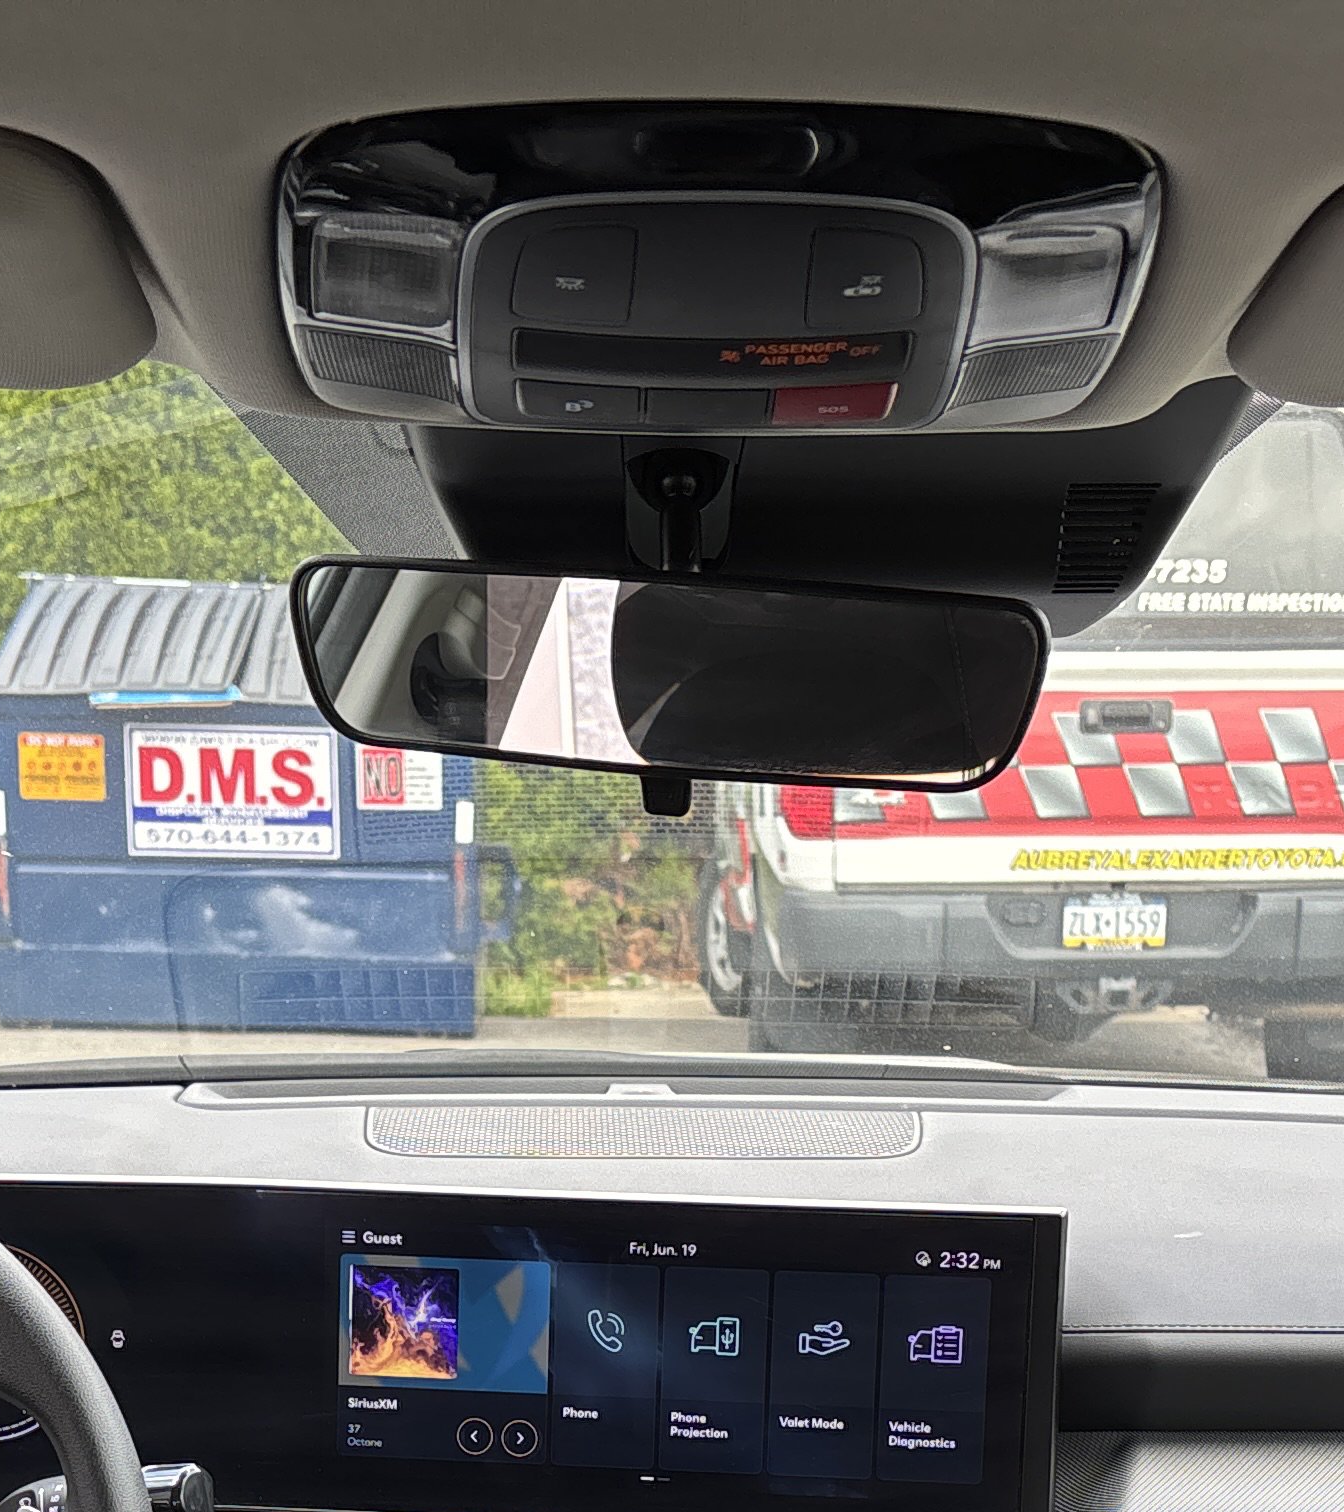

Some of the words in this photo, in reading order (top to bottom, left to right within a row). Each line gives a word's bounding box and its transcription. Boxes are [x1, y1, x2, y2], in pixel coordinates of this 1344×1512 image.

[744, 342, 848, 354] PASSENGER
[849, 345, 881, 357] OFF
[760, 355, 789, 365] AIR
[794, 354, 830, 365] BAG
[818, 406, 849, 414] SOS
[1148, 559, 1227, 584] 7235
[1137, 592, 1186, 612] FREE
[1188, 592, 1245, 612] STATE
[138, 746, 325, 806] D.M.S.
[363, 757, 403, 798] NO
[363, 1231, 403, 1245] Guest
[629, 1242, 649, 1257] Fri,
[652, 1243, 678, 1257] Jun.
[682, 1244, 697, 1257] 19
[939, 1251, 980, 1269] 2:32
[983, 1259, 1001, 1270] PM
[347, 1397, 398, 1410] SiriusXM
[562, 1407, 599, 1419] Phone
[670, 1411, 707, 1424] Phone
[347, 1424, 361, 1434] 37
[779, 1416, 809, 1429] Valet
[811, 1417, 845, 1430] Mode
[889, 1421, 932, 1434] Vehicle
[670, 1425, 729, 1440] Projection
[347, 1436, 383, 1448] Octane
[888, 1435, 956, 1450] Diagnostics
